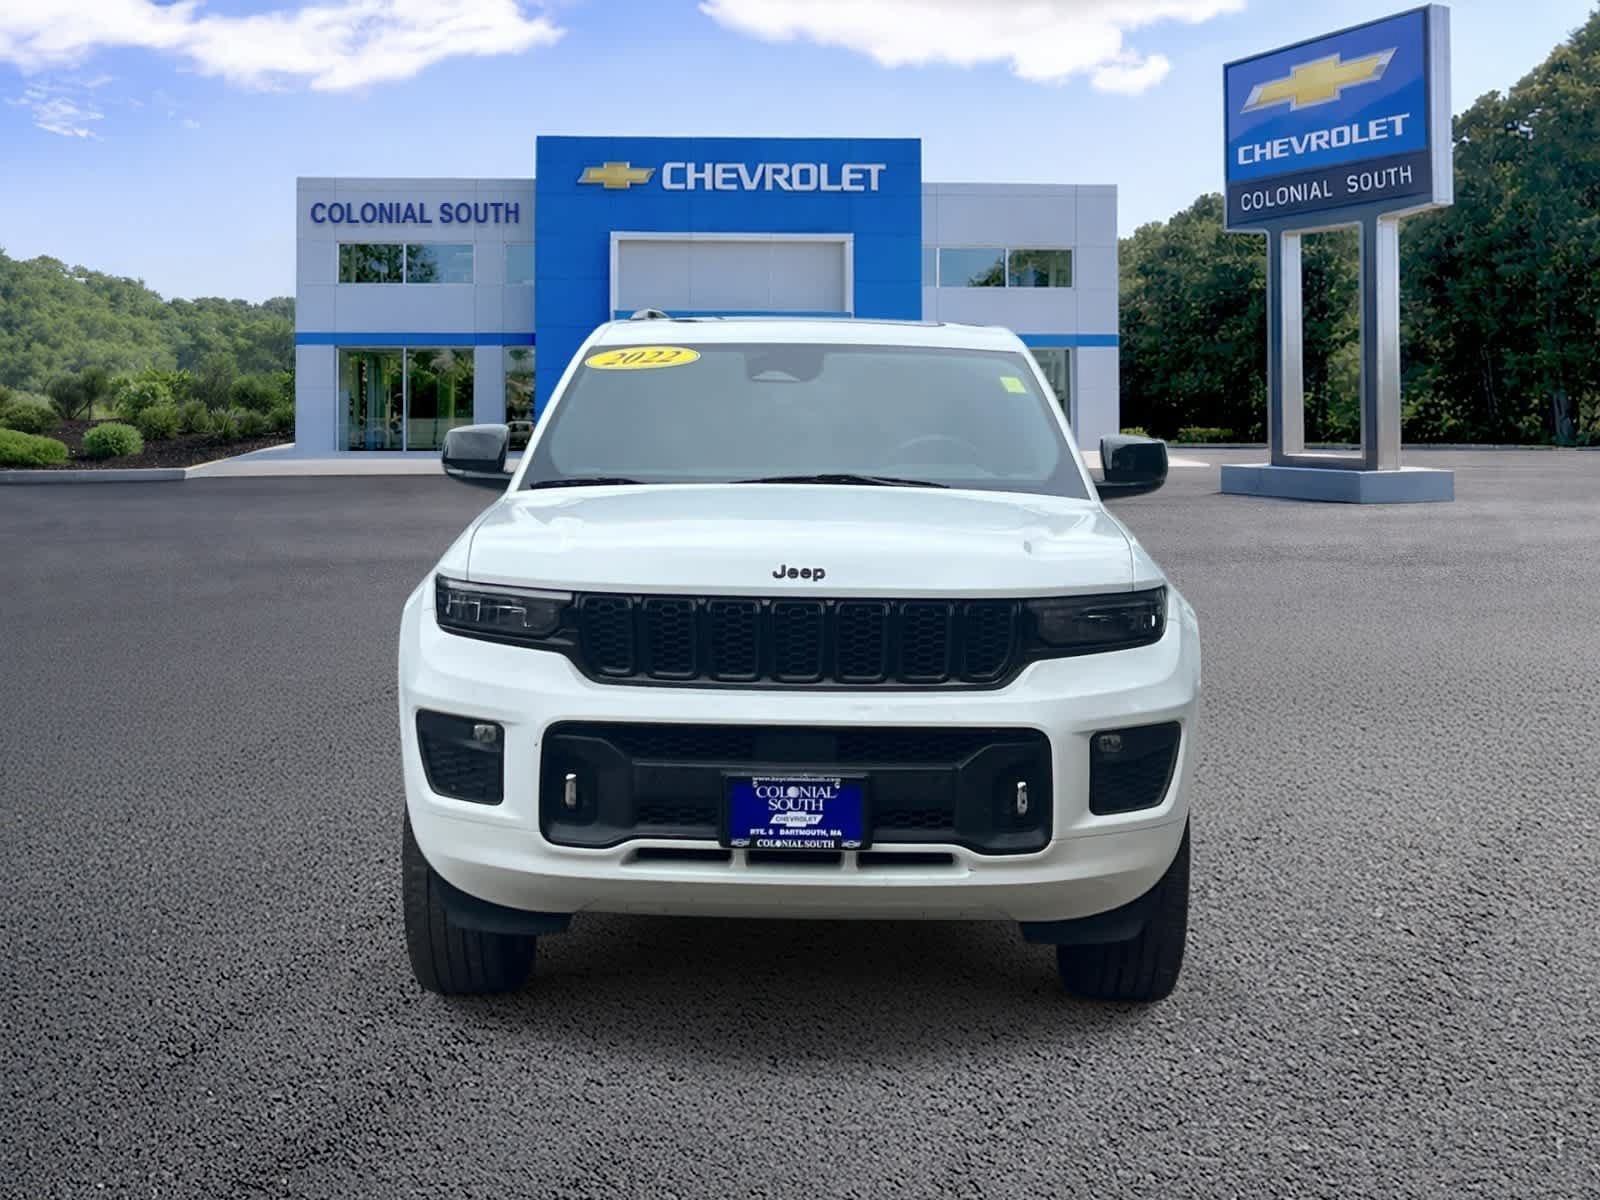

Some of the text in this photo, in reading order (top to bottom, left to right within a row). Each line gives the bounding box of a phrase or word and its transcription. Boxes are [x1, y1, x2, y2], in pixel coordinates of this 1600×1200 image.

[1237, 113, 1410, 165] CHEVROLET
[662, 162, 887, 191] CHEVROLET
[1240, 165, 1412, 211] COLONIAL SOUTH
[310, 202, 520, 224] COLONIAL SOUTH
[602, 350, 681, 366] 2022
[772, 564, 826, 582] Jeep
[756, 785, 838, 798] COLONIAL
[768, 798, 824, 811] SOUTH
[756, 839, 835, 848] COLONIAL SOUTH
